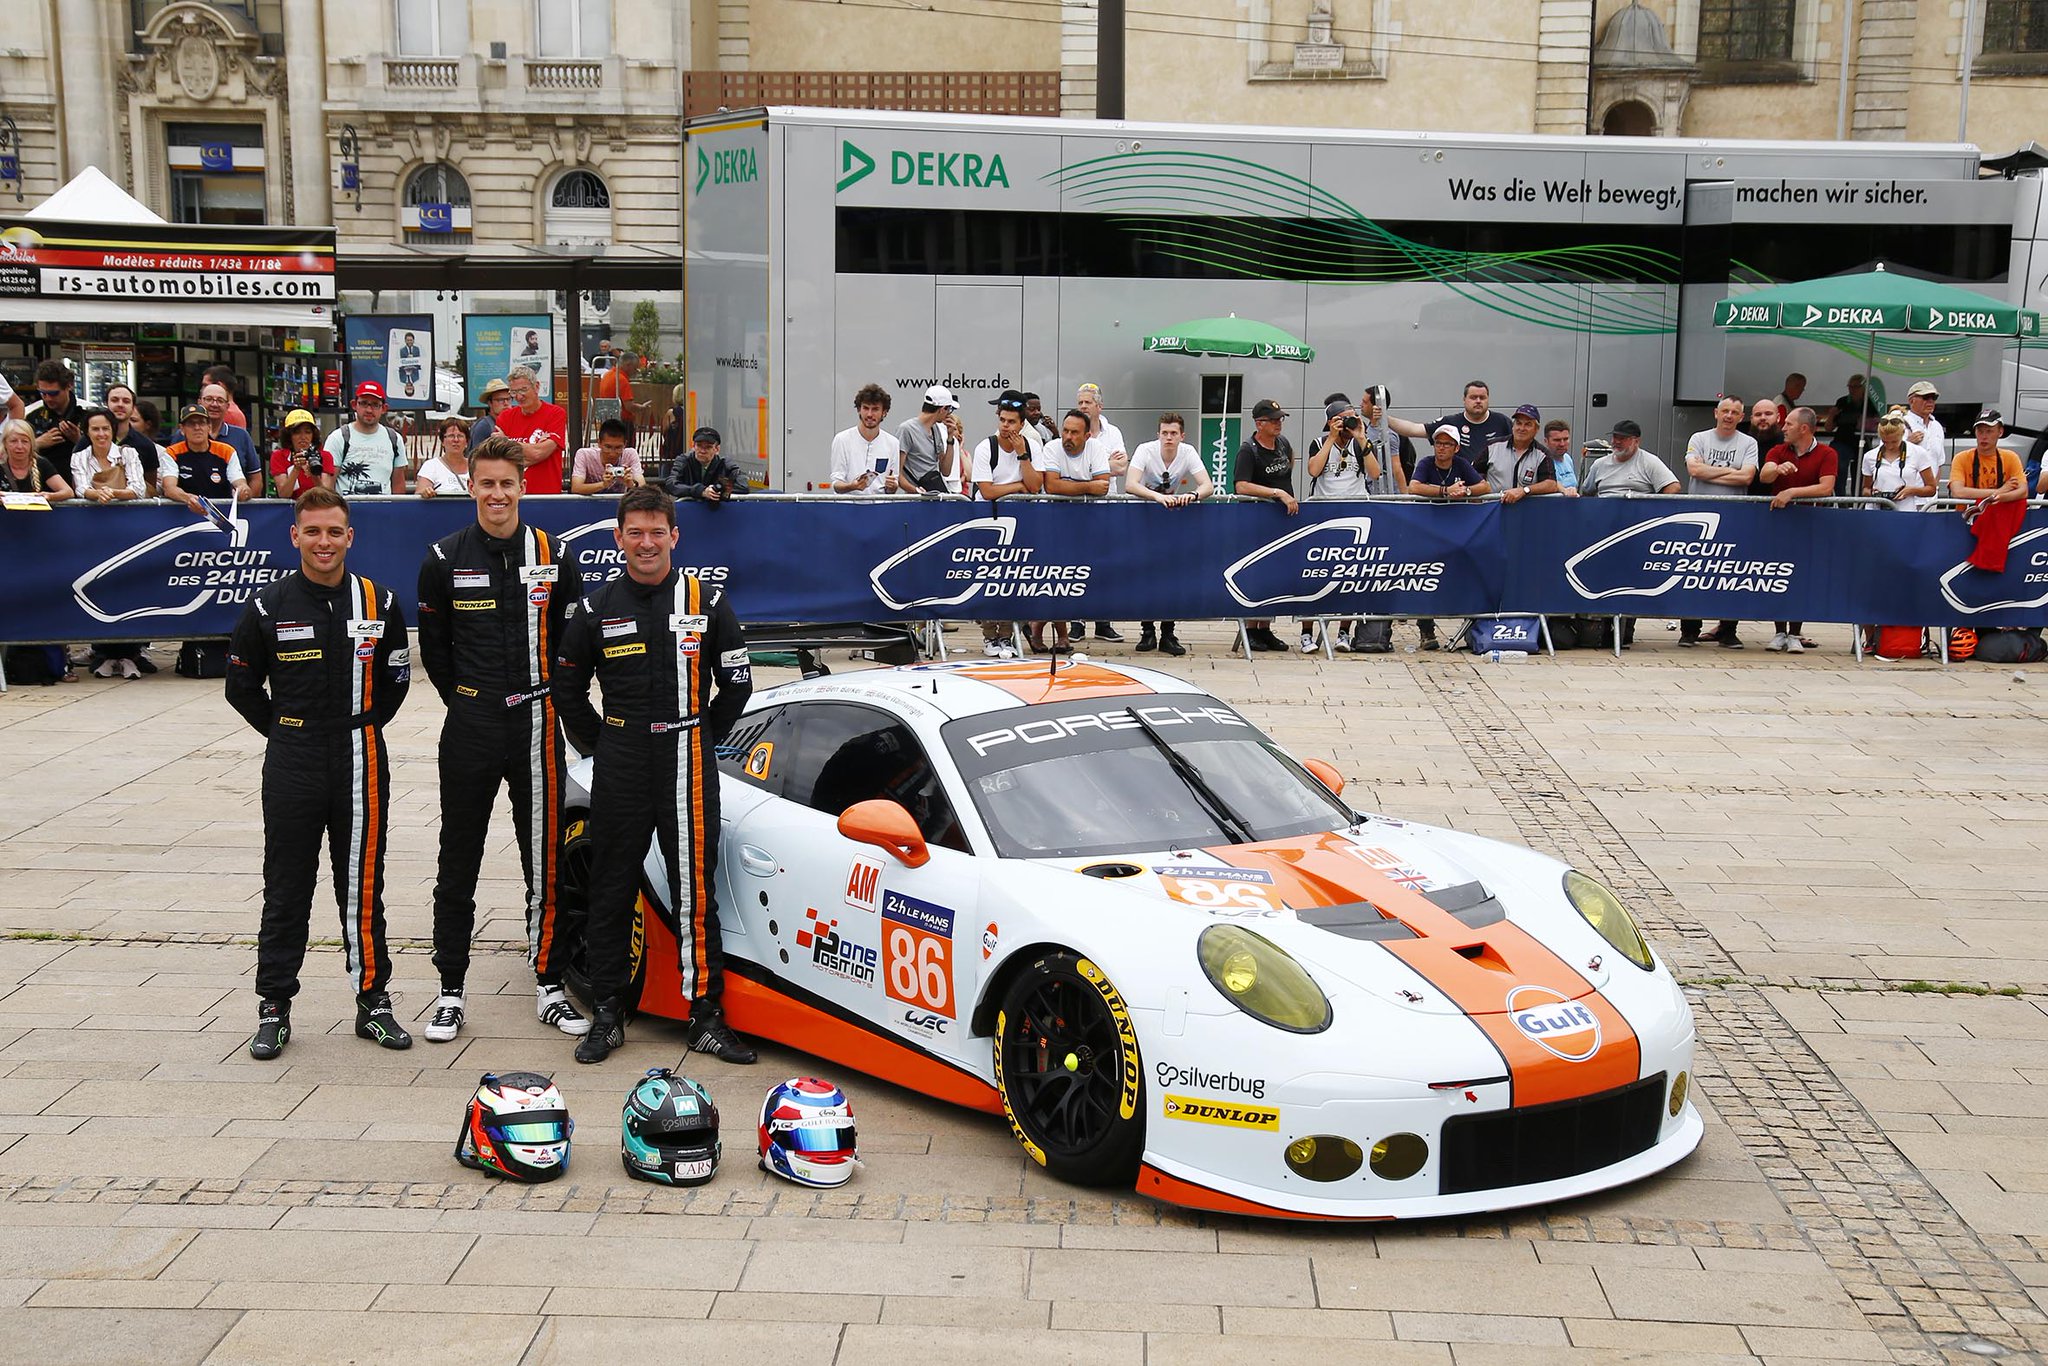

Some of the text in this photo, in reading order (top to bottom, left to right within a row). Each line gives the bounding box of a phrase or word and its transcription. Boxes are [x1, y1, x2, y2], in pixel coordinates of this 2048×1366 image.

[201, 148, 227, 158] LCL
[714, 147, 758, 184] DEKRA
[892, 150, 1010, 188] DEKRA
[1448, 178, 1682, 210] Was die Welt bewegt,
[1736, 179, 1928, 204] machen wir sicher.
[420, 208, 444, 220] LCL
[103, 254, 282, 270] Modèles réduits 1/43è 1/18è
[58, 274, 321, 296] rs-automobiles.com
[1740, 306, 1770, 322] DEKRA
[1828, 308, 1884, 324] DEKRA
[1948, 312, 1996, 329] DEKRA
[1159, 337, 1180, 346] DEKRA
[1275, 344, 1300, 356] DEKRA
[716, 352, 758, 370] www.dekra.de
[896, 373, 1010, 390] wwwdekra.de
[1324, 462, 1360, 473] SPRS
[952, 548, 1034, 562] CIRCUIT
[1306, 547, 1390, 561] CIRCUIT
[1649, 540, 1736, 557] CIRCUIT
[174, 550, 272, 567] CIRCUIT
[579, 550, 627, 564] CIRC
[2030, 552, 2048, 566] C
[530, 568, 558, 576] WEC
[580, 572, 602, 582] ES
[606, 568, 625, 582] 2
[946, 566, 1092, 580] DES 24 HEURES
[1302, 562, 1445, 578] DES 24 HEURES
[1642, 559, 1795, 576] DES 24 HEURES
[167, 569, 298, 586] DES 24 HEU
[1682, 576, 1790, 593] DU MANS
[984, 582, 1086, 596] DU MANS
[1340, 578, 1440, 594] DU MANS
[529, 593, 549, 601] Gulf
[357, 623, 383, 631] WEC
[678, 618, 706, 626] WEC
[284, 651, 320, 660] DUNLOP
[356, 650, 375, 658] Gulf
[610, 646, 644, 656] DUNLOP
[966, 707, 1248, 757] PORSCHE
[846, 862, 880, 904] AM
[886, 896, 906, 916] 24h
[906, 906, 919, 919] LE
[919, 910, 949, 928] MANS
[982, 931, 997, 952] Gulf
[839, 940, 878, 968] one
[812, 962, 874, 989] MOTORSPORTS
[890, 928, 948, 1009] 86
[904, 1010, 948, 1034] WEC
[1518, 1006, 1592, 1034] Gulf
[1094, 977, 1140, 1108] DUNLOP
[1179, 1067, 1266, 1098] silverbug
[824, 1118, 852, 1126] RACING
[1182, 1104, 1276, 1124] DUNLOP
[676, 1161, 712, 1175] CARS
